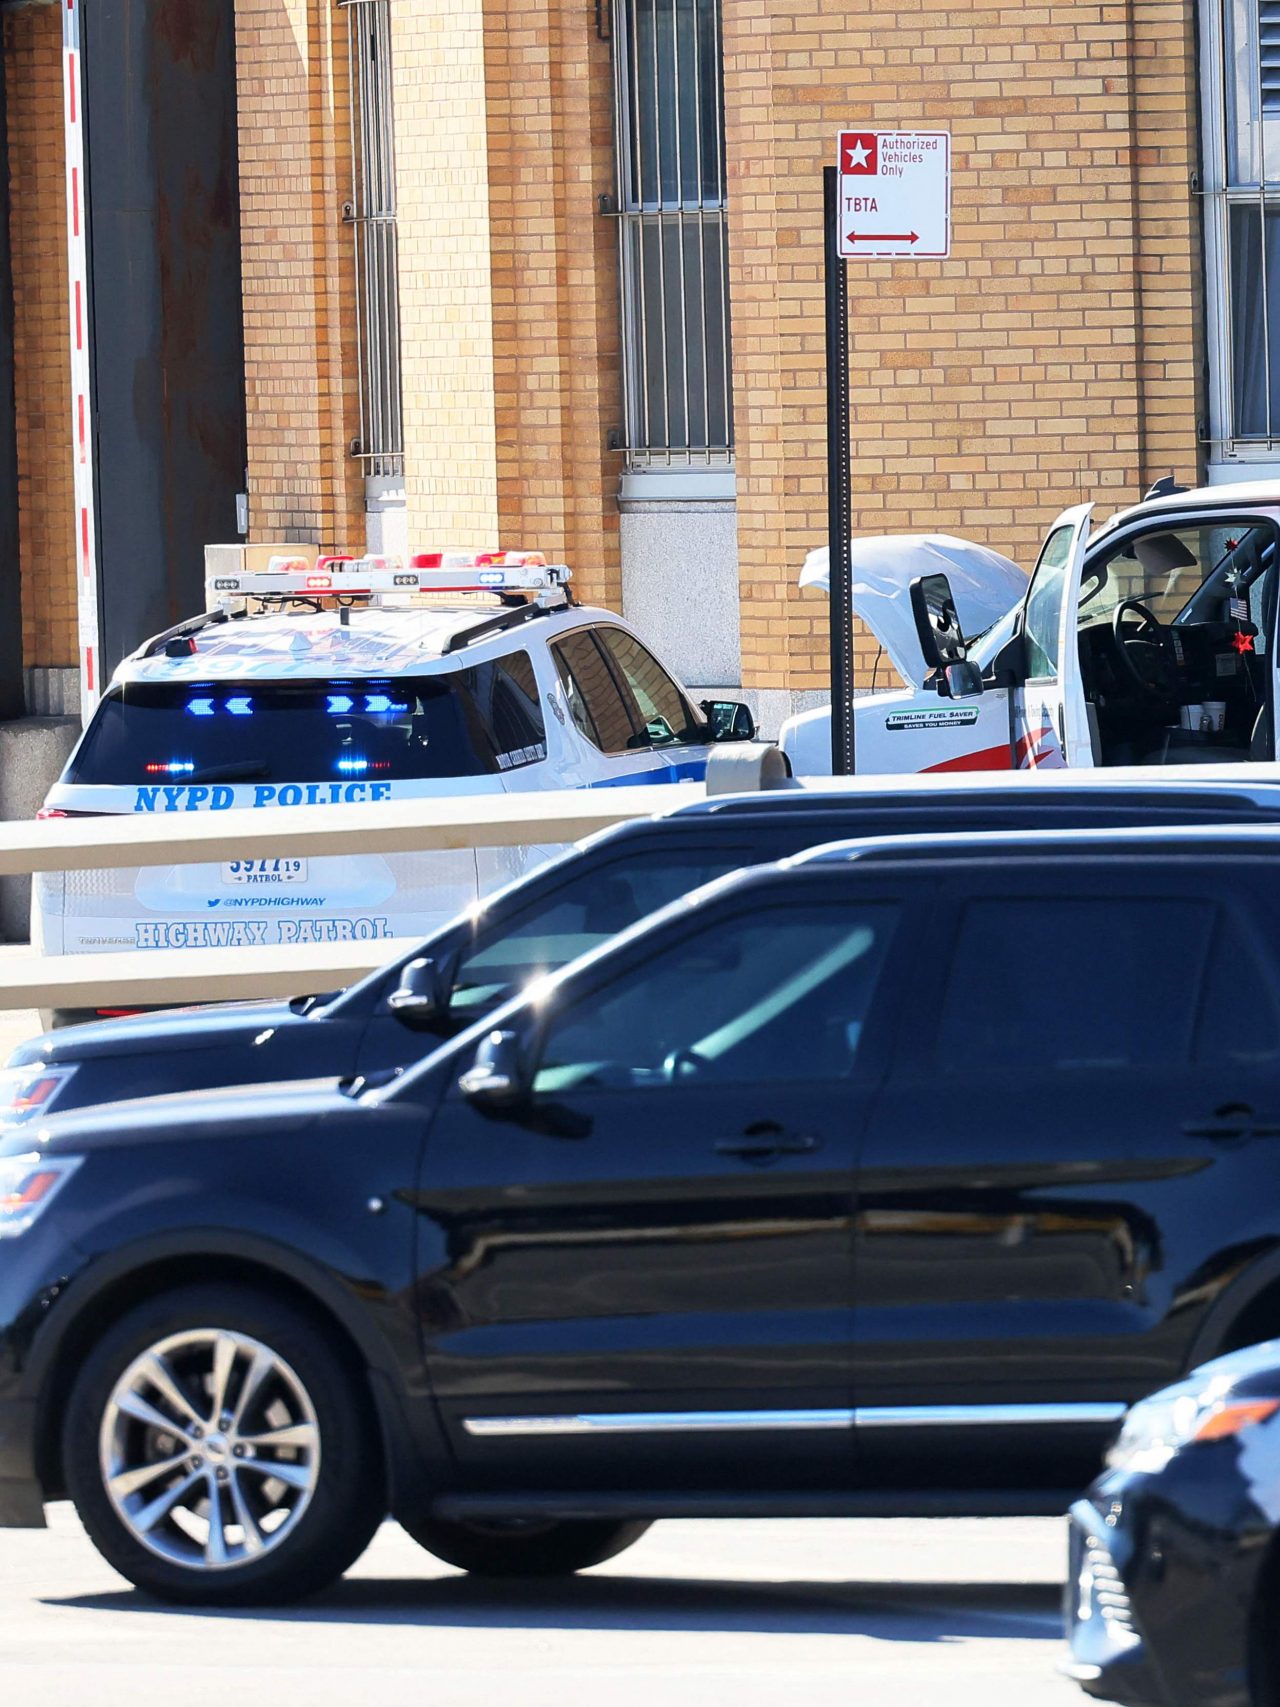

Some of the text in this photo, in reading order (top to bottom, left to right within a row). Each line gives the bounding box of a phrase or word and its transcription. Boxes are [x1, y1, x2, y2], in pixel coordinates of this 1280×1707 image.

[882, 139, 938, 150] Authorized
[882, 152, 923, 163] Vehicles
[882, 165, 904, 178] Only
[845, 197, 878, 212] TBTA
[892, 714, 926, 722] TRIMLINE
[134, 782, 392, 812] NYPD POLICE
[247, 873, 283, 882] PATROL
[224, 896, 326, 908] @NYPDHIGHWAY
[136, 918, 394, 948] HIGHWAY PATROL
